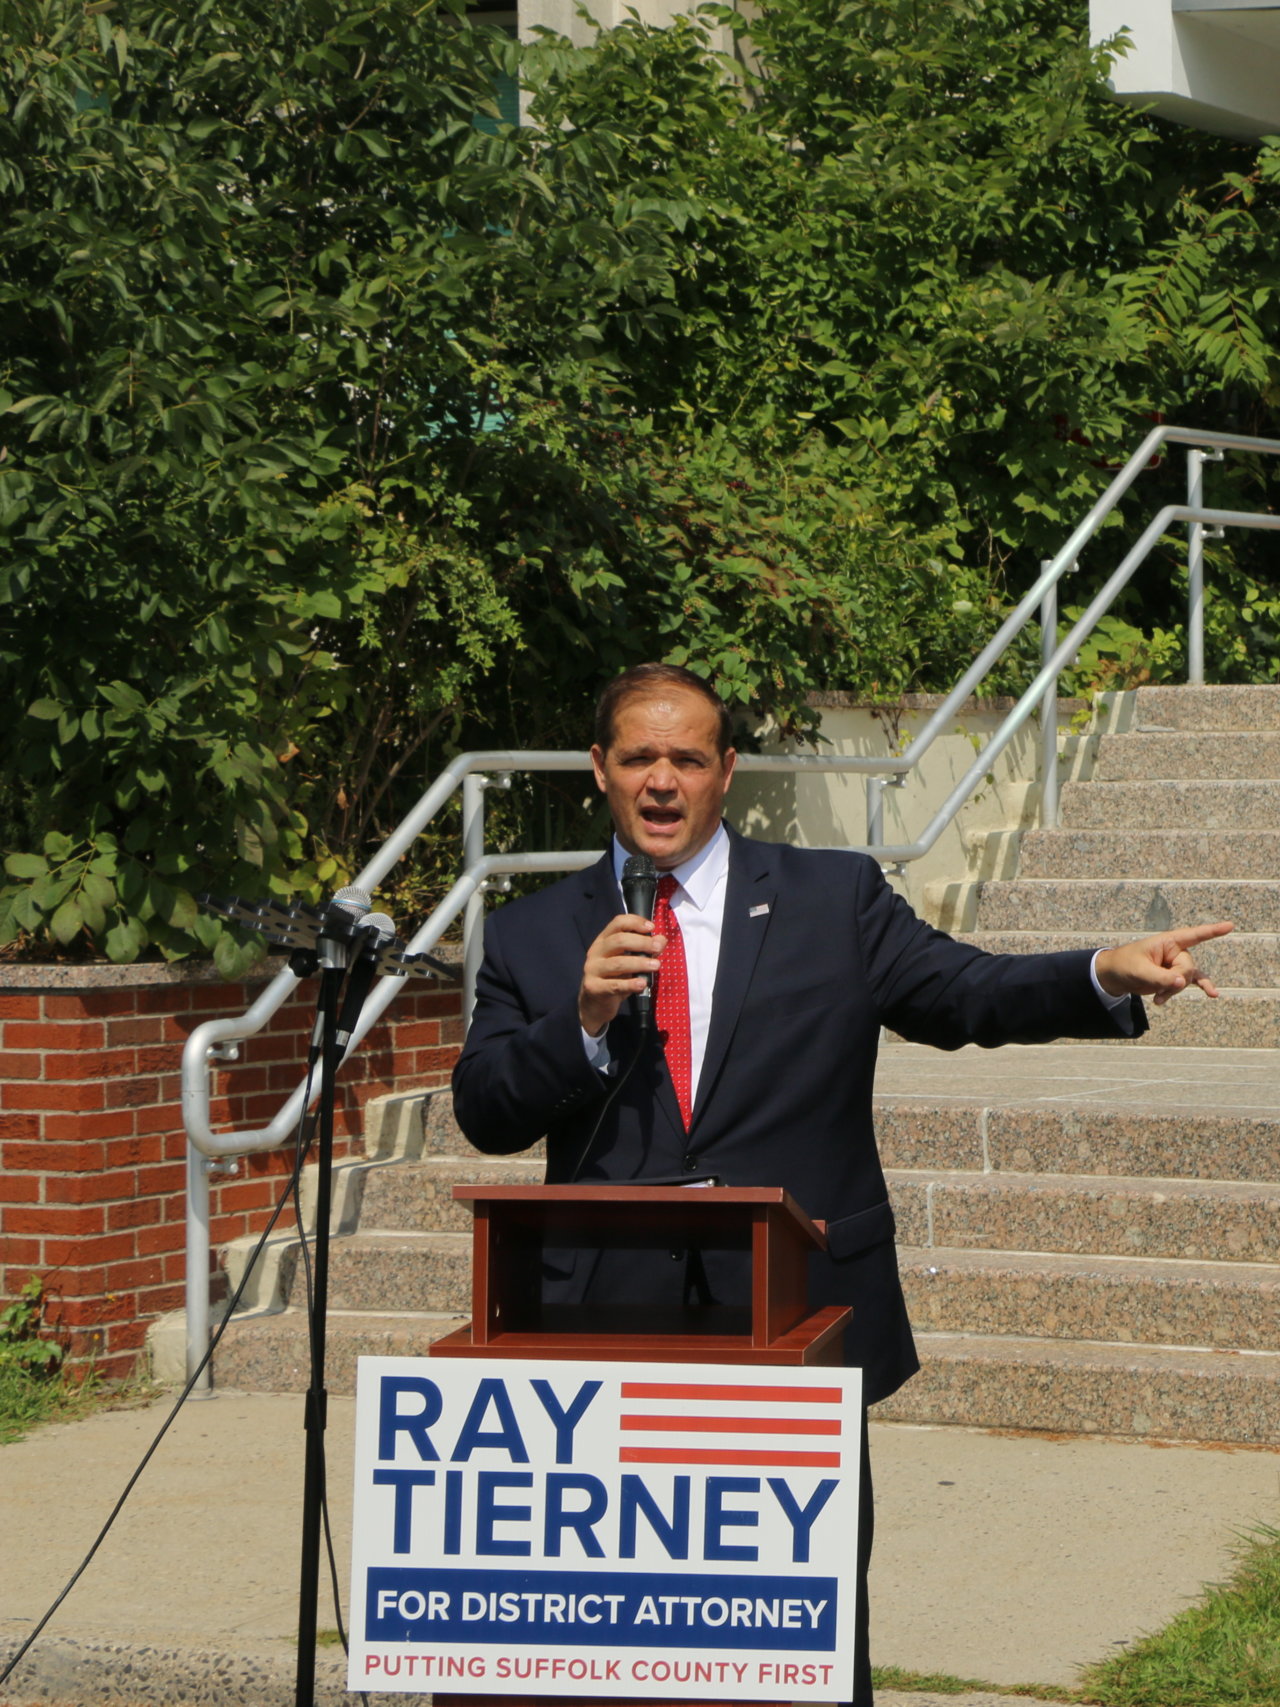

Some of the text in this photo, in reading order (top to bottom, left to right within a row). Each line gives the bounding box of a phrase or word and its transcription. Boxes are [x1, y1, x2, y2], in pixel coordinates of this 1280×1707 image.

[378, 1375, 604, 1465] RAY
[373, 1468, 840, 1563] TIERNEY
[376, 1590, 828, 1629] FOR DISTRICT ATTORNEY
[364, 1655, 834, 1686] PUTTING SUFFOLK COUNTY FIRST
